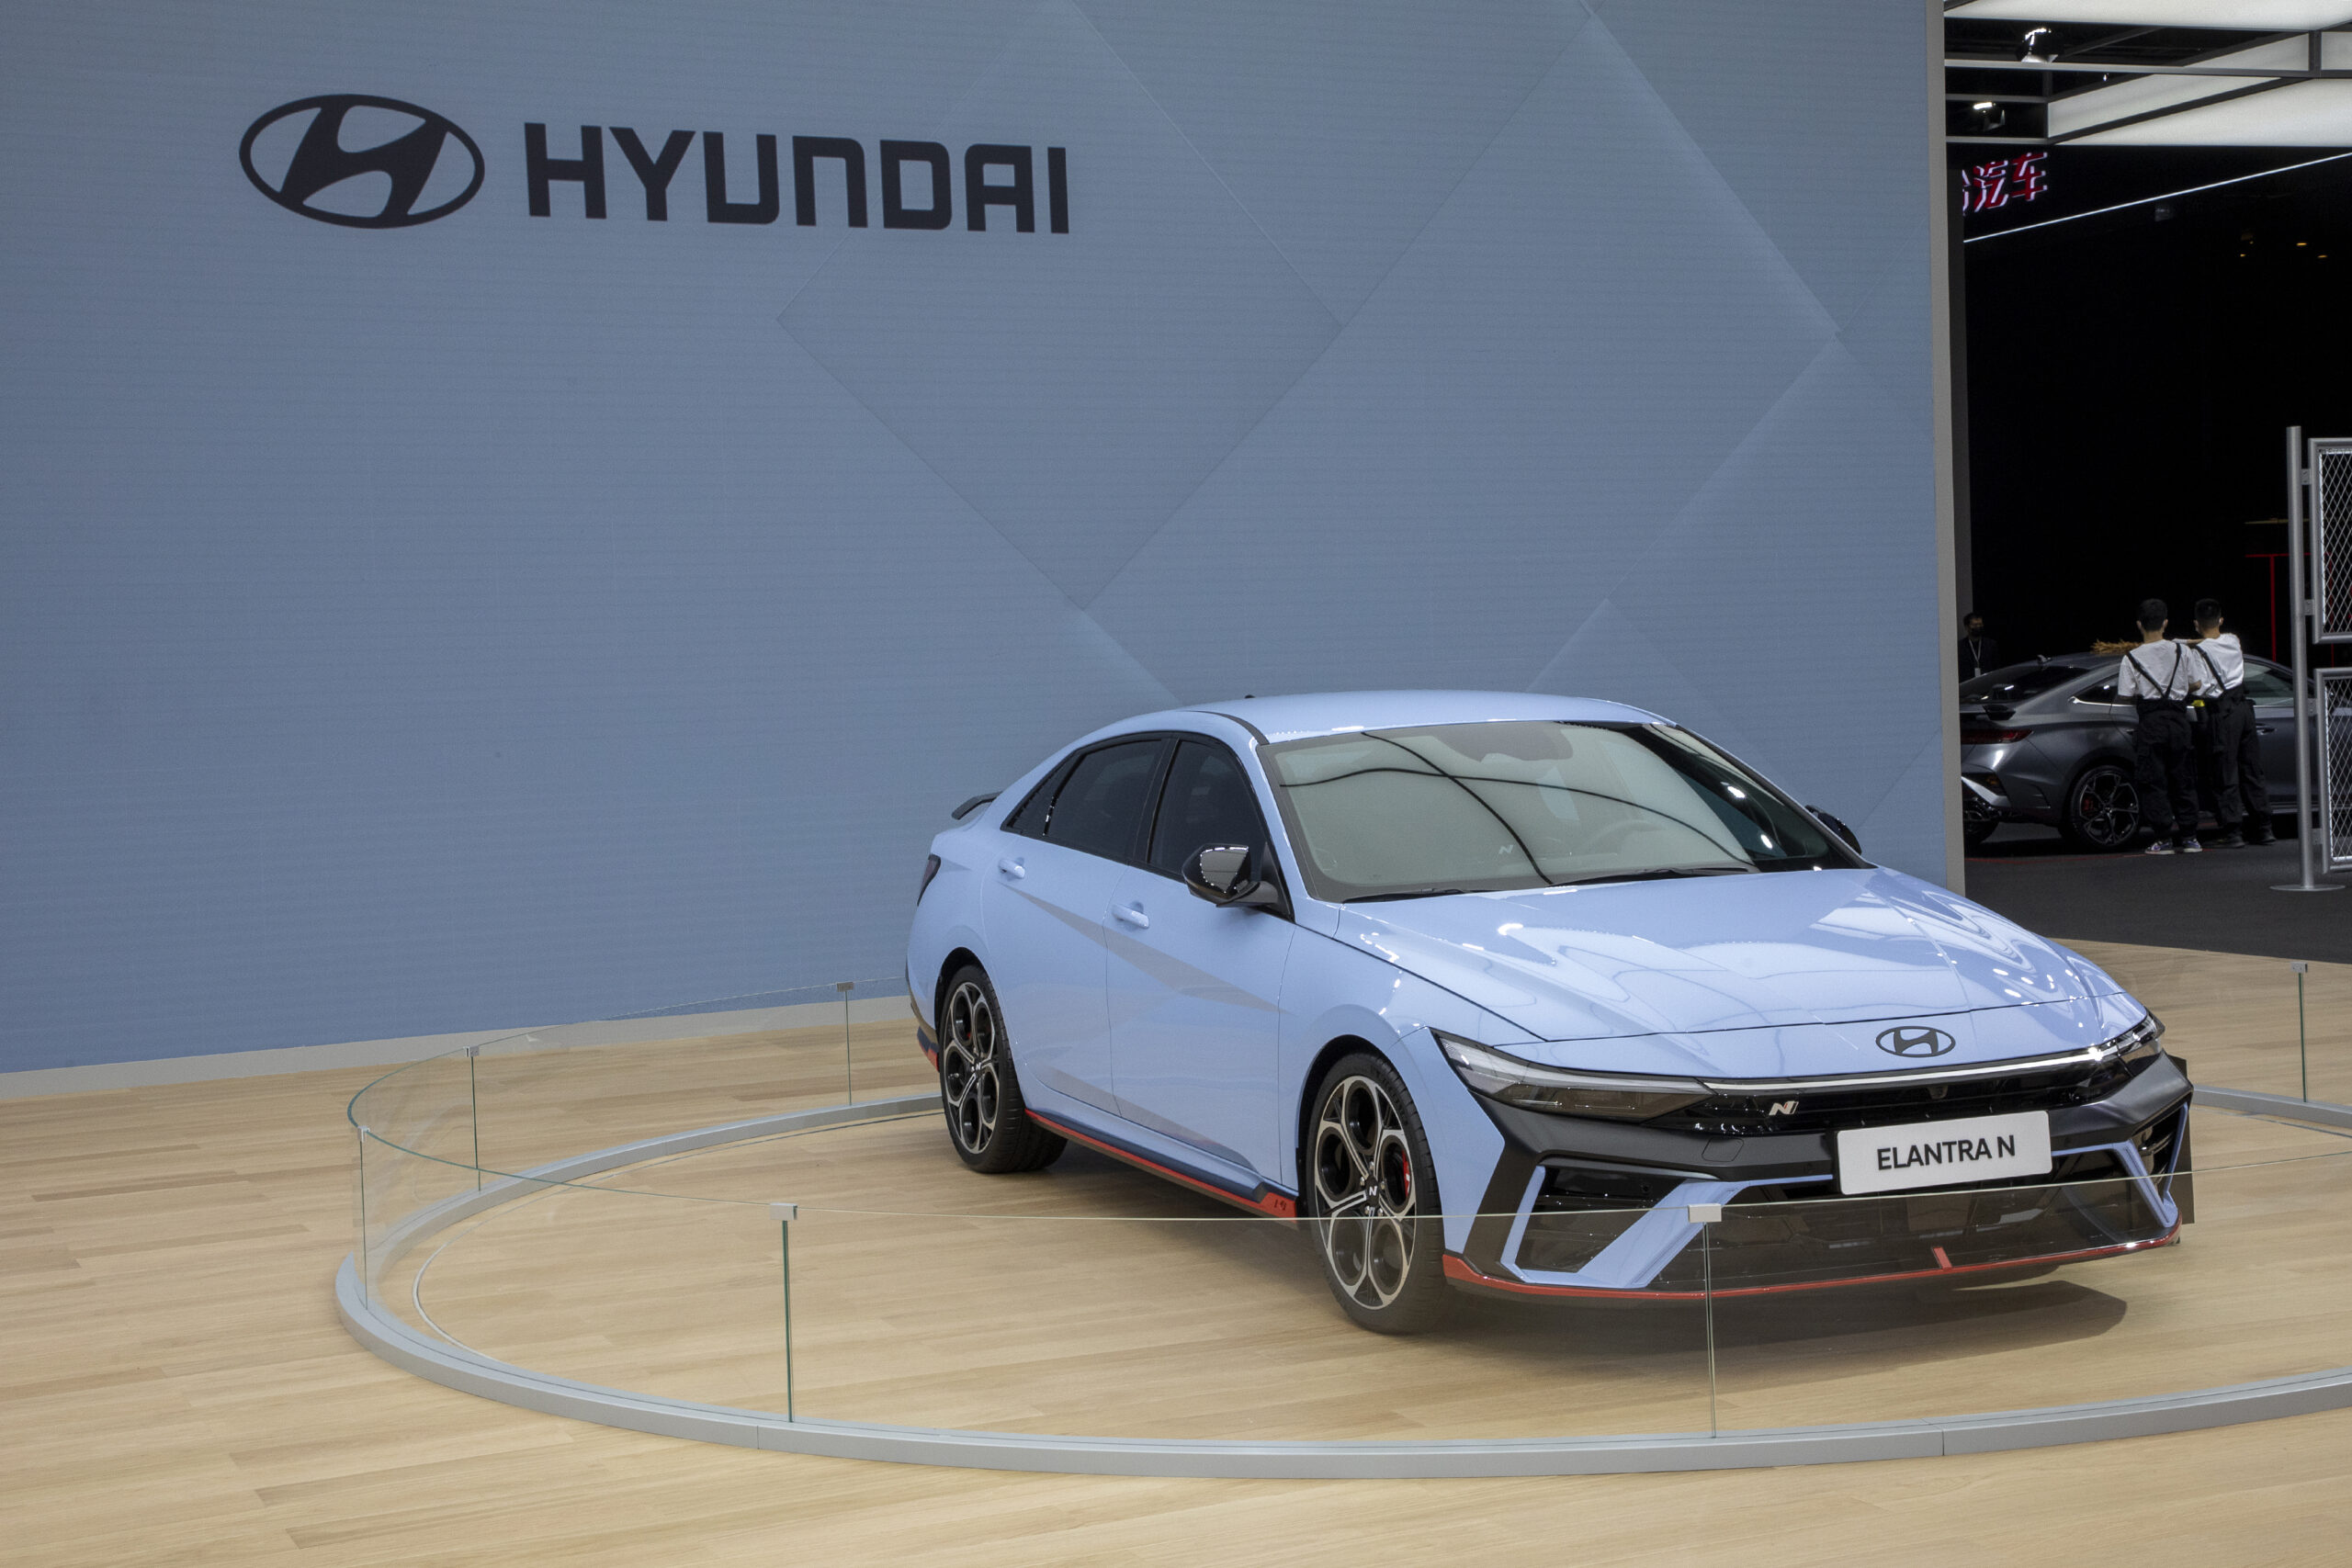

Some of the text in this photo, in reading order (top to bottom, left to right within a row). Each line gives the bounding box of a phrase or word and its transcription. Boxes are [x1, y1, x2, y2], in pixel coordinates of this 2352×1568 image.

[524, 122, 1069, 233] HYUNDAI
[1877, 1134, 2016, 1171] ELANTRA N
[1369, 1185, 1378, 1196] N
